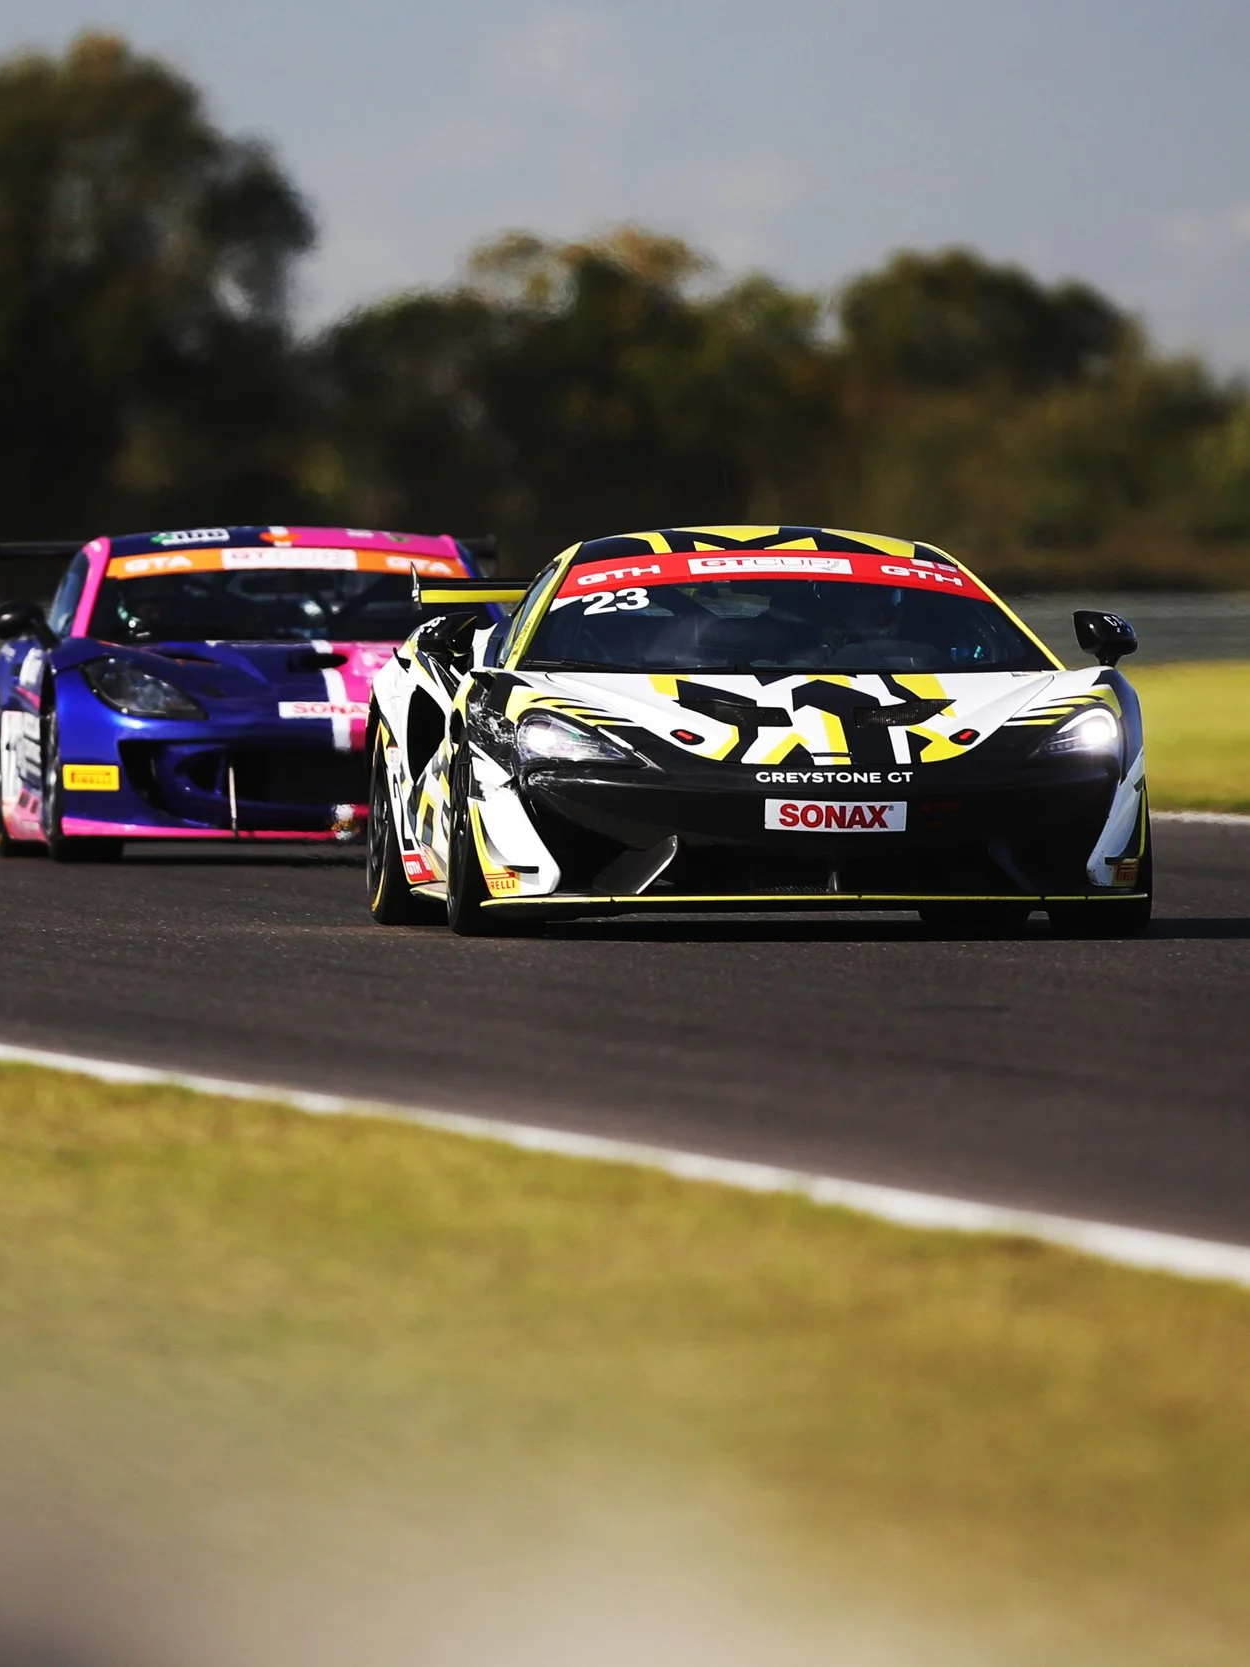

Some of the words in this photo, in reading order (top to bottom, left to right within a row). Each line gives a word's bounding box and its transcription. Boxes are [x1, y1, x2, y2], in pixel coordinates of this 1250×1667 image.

[124, 556, 193, 573] GTA
[577, 564, 661, 586] GTH
[880, 565, 964, 587] GTH
[581, 587, 651, 616] 23
[292, 703, 368, 714] SONA
[755, 772, 882, 783] GREYSTONE
[887, 772, 914, 783] GT
[778, 803, 889, 829] SONAX
